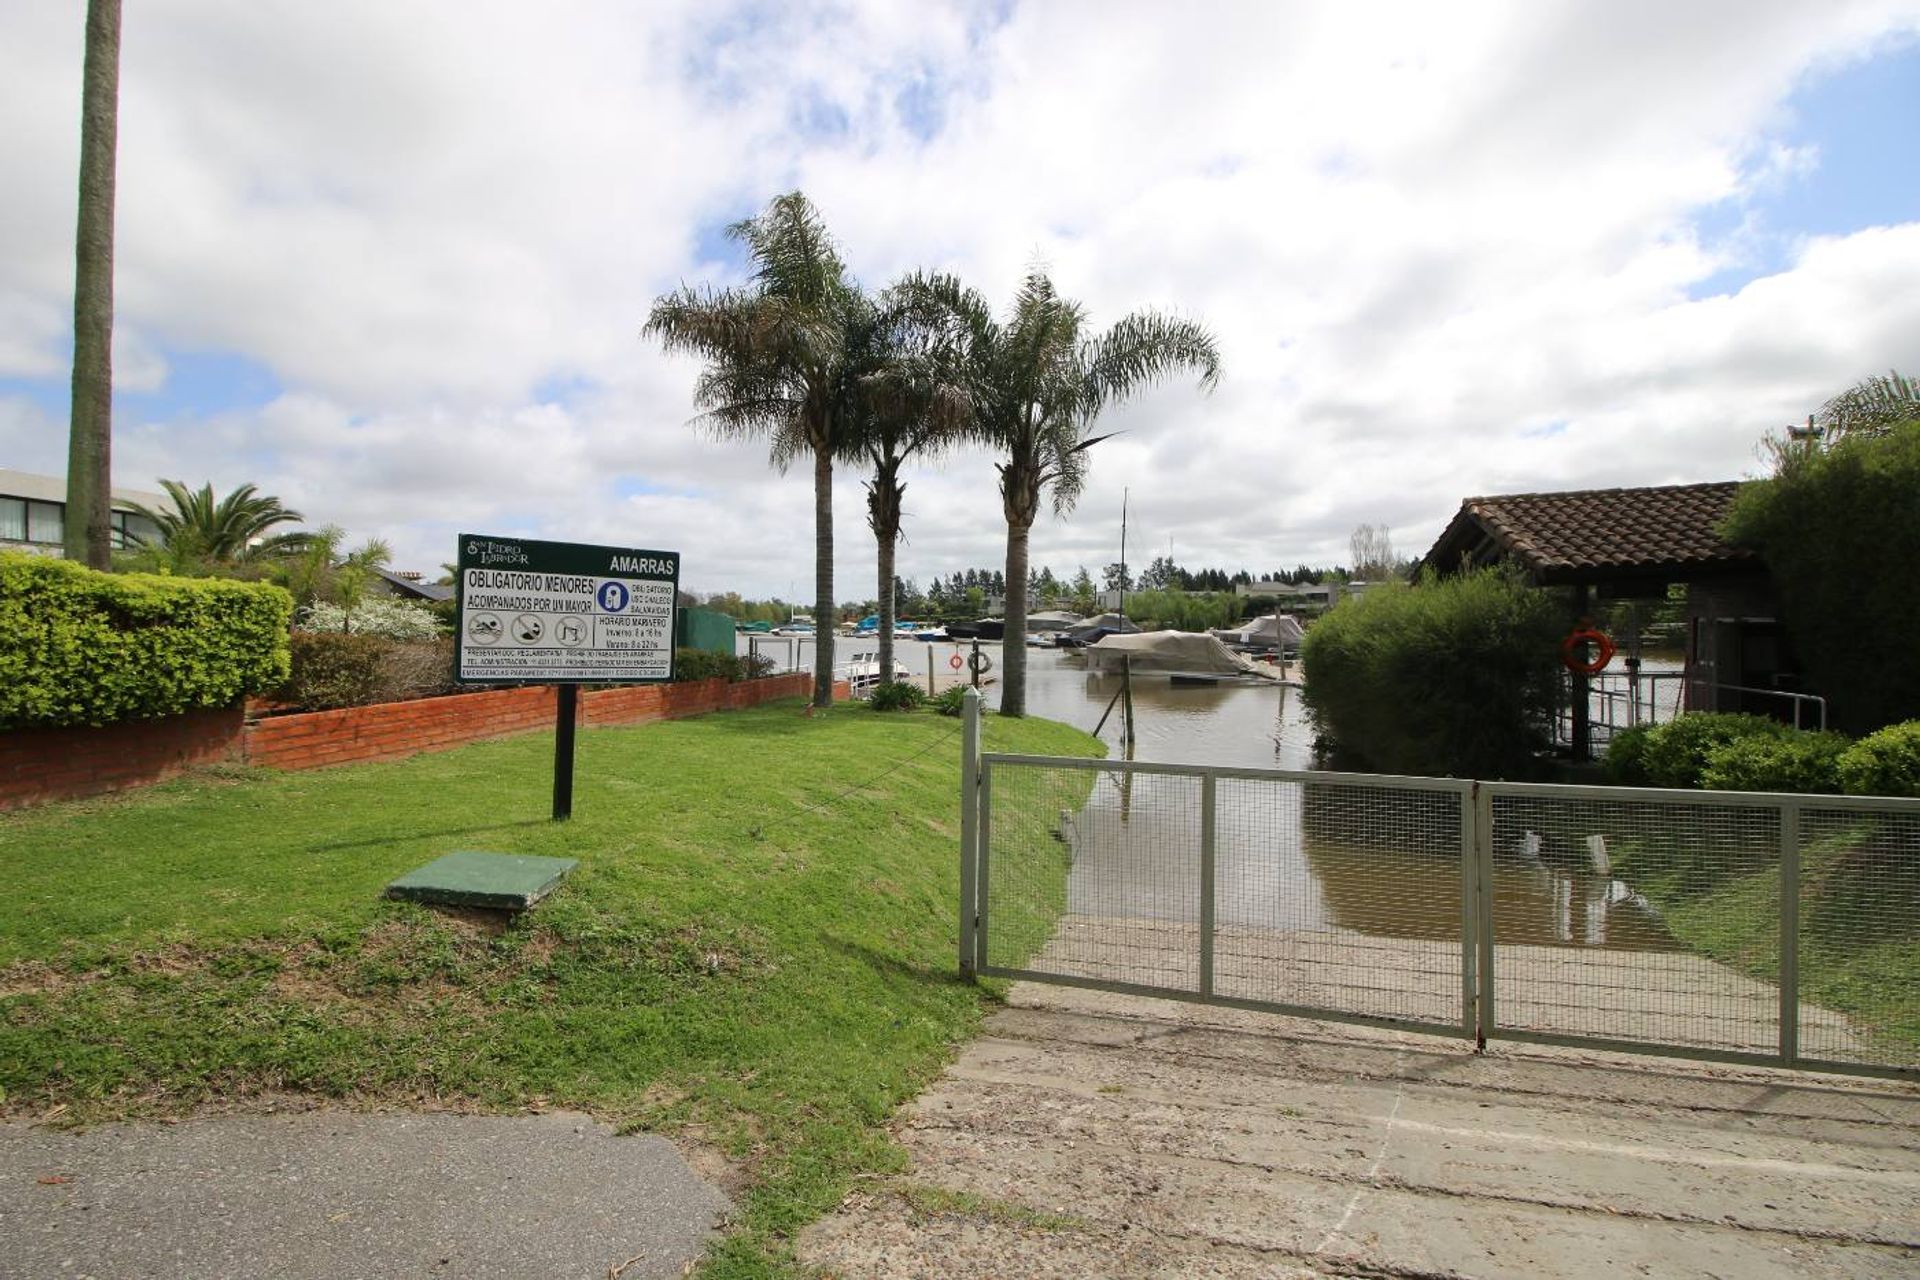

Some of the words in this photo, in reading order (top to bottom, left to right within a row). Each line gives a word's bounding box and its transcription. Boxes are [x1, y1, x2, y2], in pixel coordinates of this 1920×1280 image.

[609, 555, 674, 575] AMARRAS
[469, 570, 543, 591] OBLIGATORIO
[544, 575, 594, 595] MENORES
[533, 597, 551, 610] POR
[552, 598, 564, 611] UN
[564, 599, 592, 613] MAYOR
[599, 617, 631, 627] HORARIO
